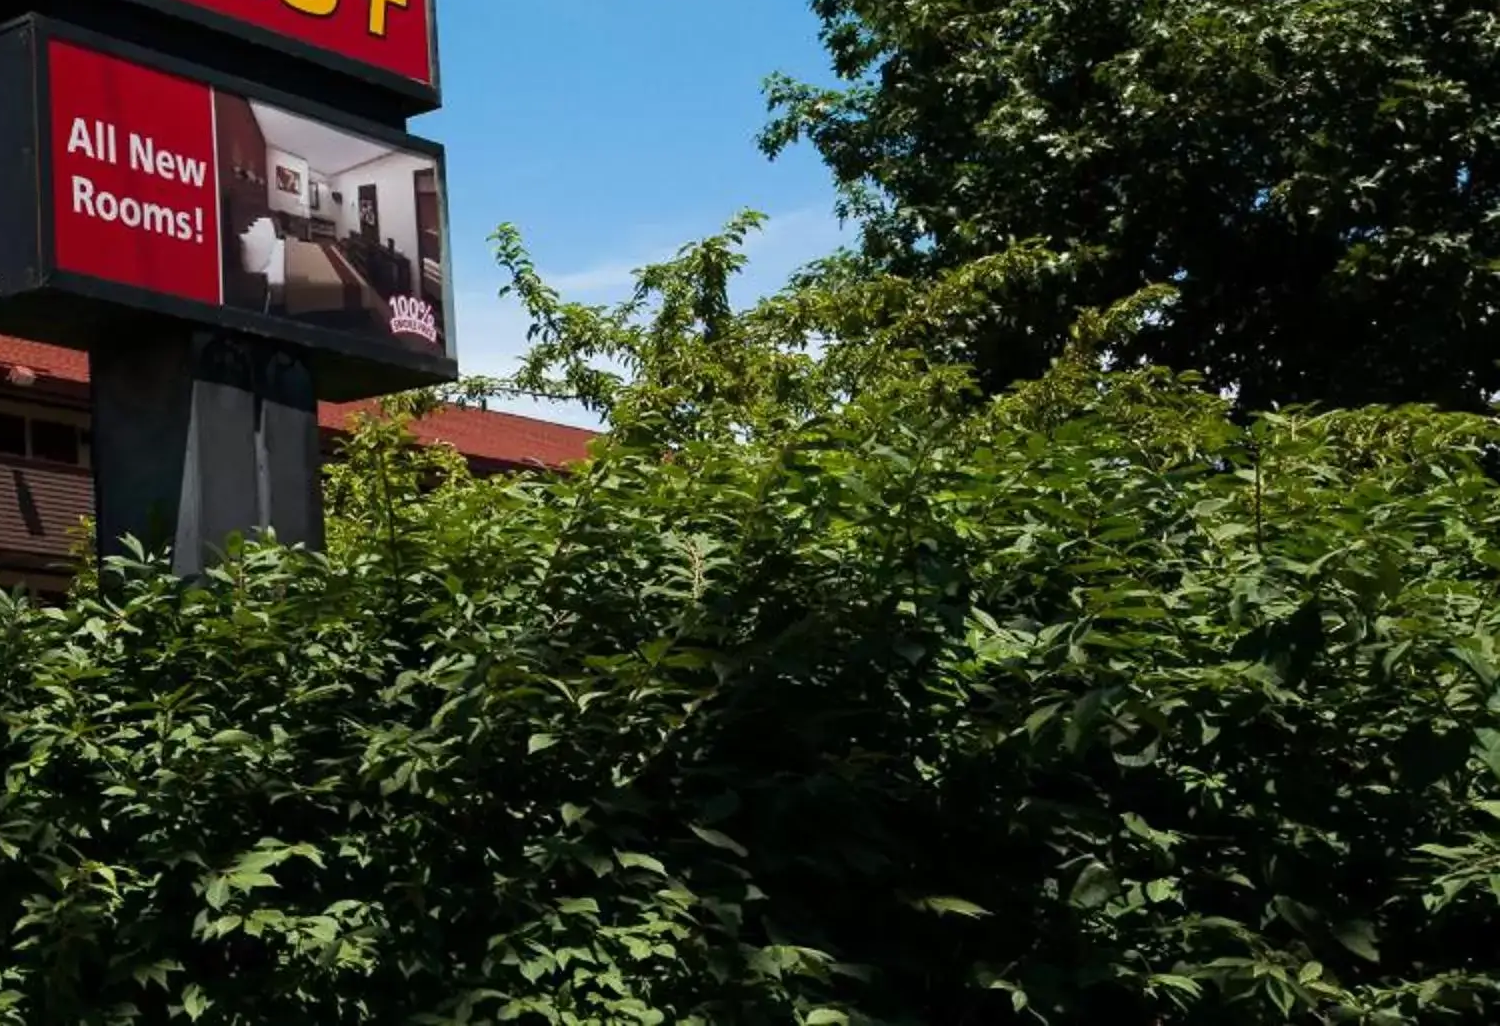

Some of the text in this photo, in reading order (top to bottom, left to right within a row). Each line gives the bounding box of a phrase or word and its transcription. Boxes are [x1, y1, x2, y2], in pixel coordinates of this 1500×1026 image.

[67, 117, 207, 187] All New
[71, 175, 204, 243] Rooms!
[389, 294, 435, 326] 100%
